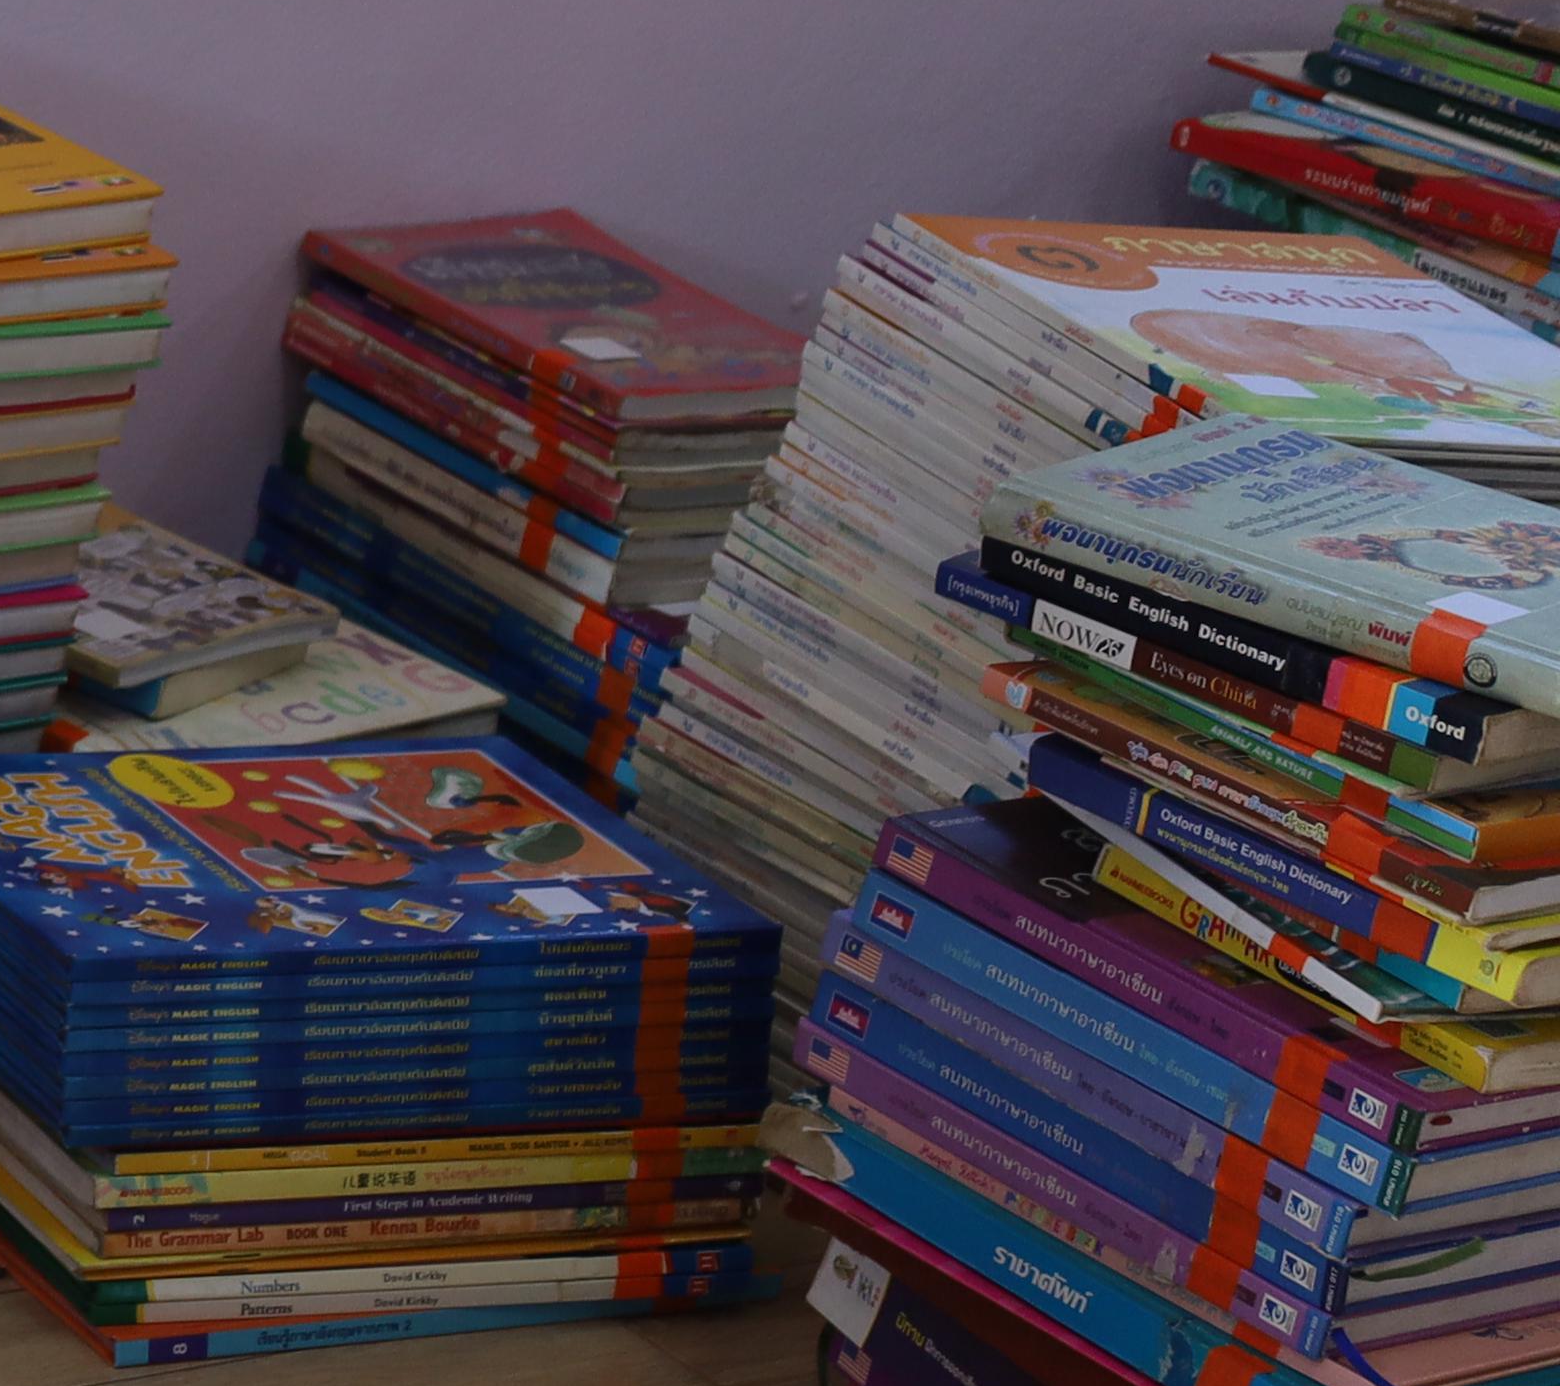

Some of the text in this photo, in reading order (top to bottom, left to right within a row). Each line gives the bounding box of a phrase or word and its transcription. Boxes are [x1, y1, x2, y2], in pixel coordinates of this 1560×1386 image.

[1117, 429, 1333, 500] พจนานุกรม
[1011, 550, 1287, 673] Oxford Basic English Dictionary
[1150, 652, 1258, 711] Eyes on China
[1210, 724, 1253, 755] ANIMALS
[1277, 754, 1315, 783] NATURE
[1405, 706, 1466, 741] Oxford
[4, 773, 196, 889] ENGLISH
[1159, 808, 1353, 905] Oxford Basic English Dictionary
[1016, 913, 1163, 1005] สนทนาภาษาอาเซียน
[930, 990, 1074, 1083] สนทนาภาษาอาเซียน
[986, 961, 1137, 1055] สนทนาภาษาอาเซียน
[534, 1138, 571, 1149] SANTOS
[940, 1062, 1085, 1156] สนทนาภาษาอาเซียน
[931, 1113, 1078, 1209] สนทนาภาษาอาเซียน
[126, 1216, 480, 1248] The Grammar Lab BOOK ONE Kenna Bourke
[343, 1199, 372, 1213] First
[375, 1196, 408, 1213] Steps
[427, 1192, 485, 1209] Academic
[487, 1190, 534, 1208] Writing
[240, 1294, 439, 1317] Patterns David Kirkby
[241, 1269, 447, 1295] Numbers David Kirkby
[993, 1243, 1095, 1316] ราชาศัพท์
[894, 1310, 926, 1346] นิทาน
